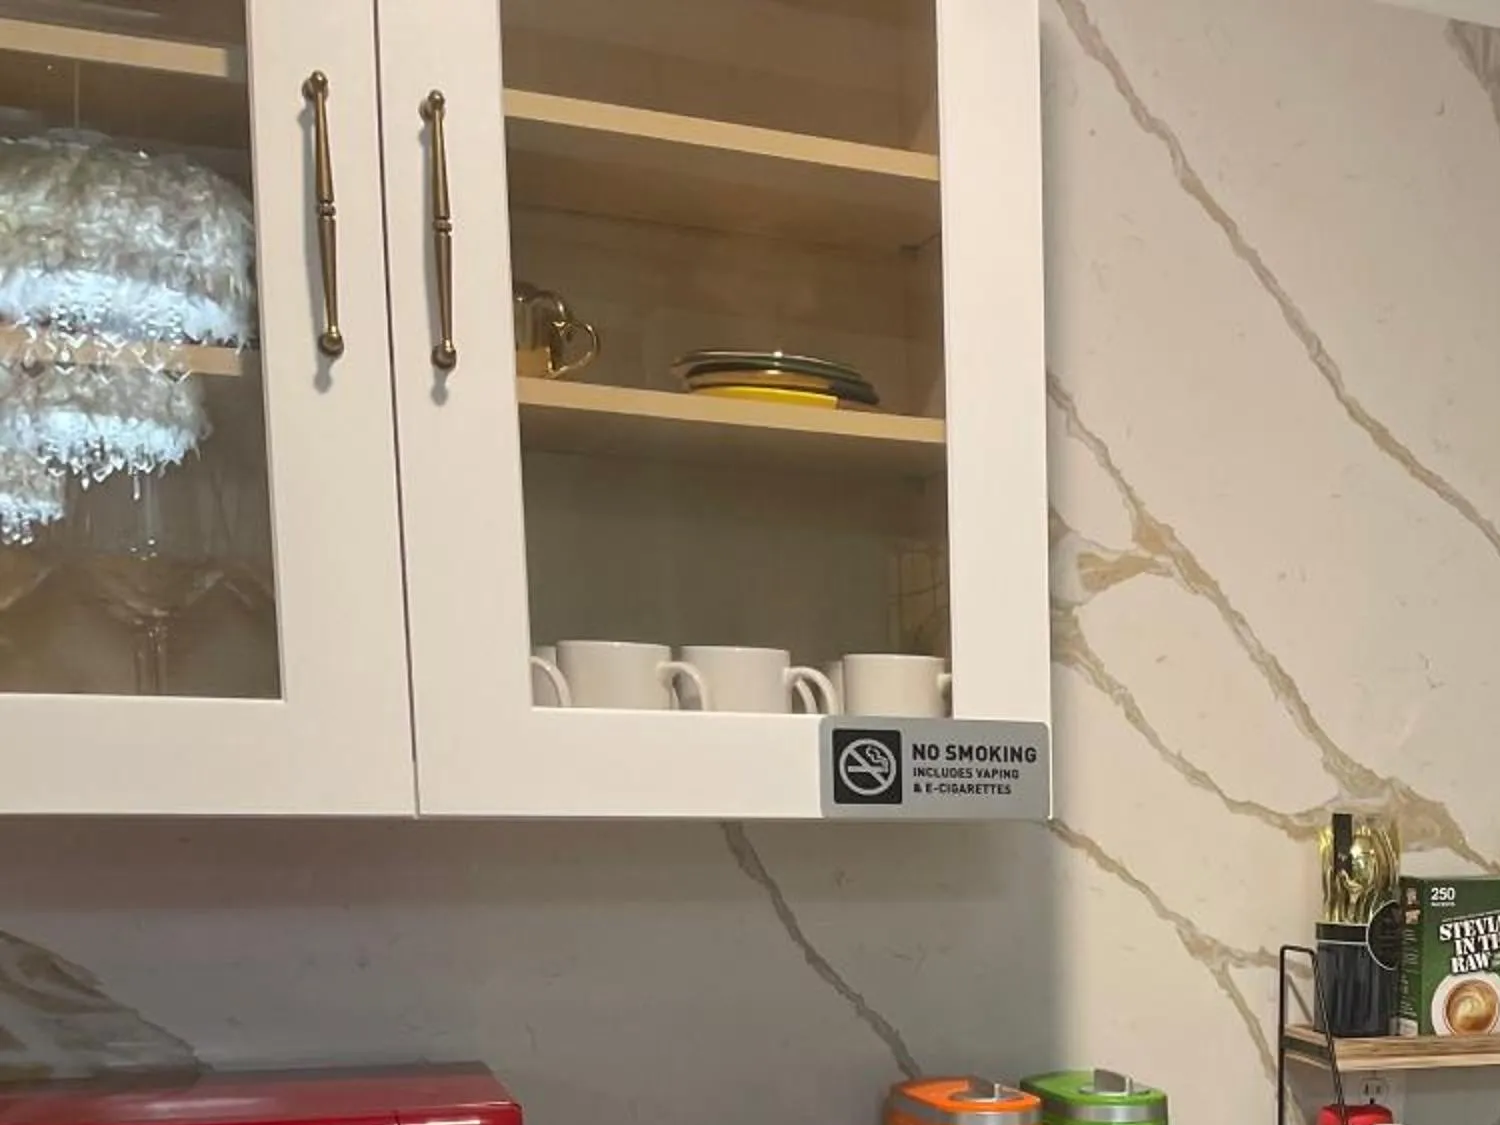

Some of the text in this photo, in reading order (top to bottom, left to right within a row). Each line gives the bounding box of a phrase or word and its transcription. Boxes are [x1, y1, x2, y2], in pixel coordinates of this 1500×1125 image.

[912, 744, 1037, 763] NO SMOKING
[913, 766, 1020, 780] INCLUDES VAPING
[913, 783, 1012, 795] & E-CIGARETTES
[1430, 887, 1456, 901] 250
[1454, 937, 1476, 957] IN
[1450, 951, 1491, 974] RAW
